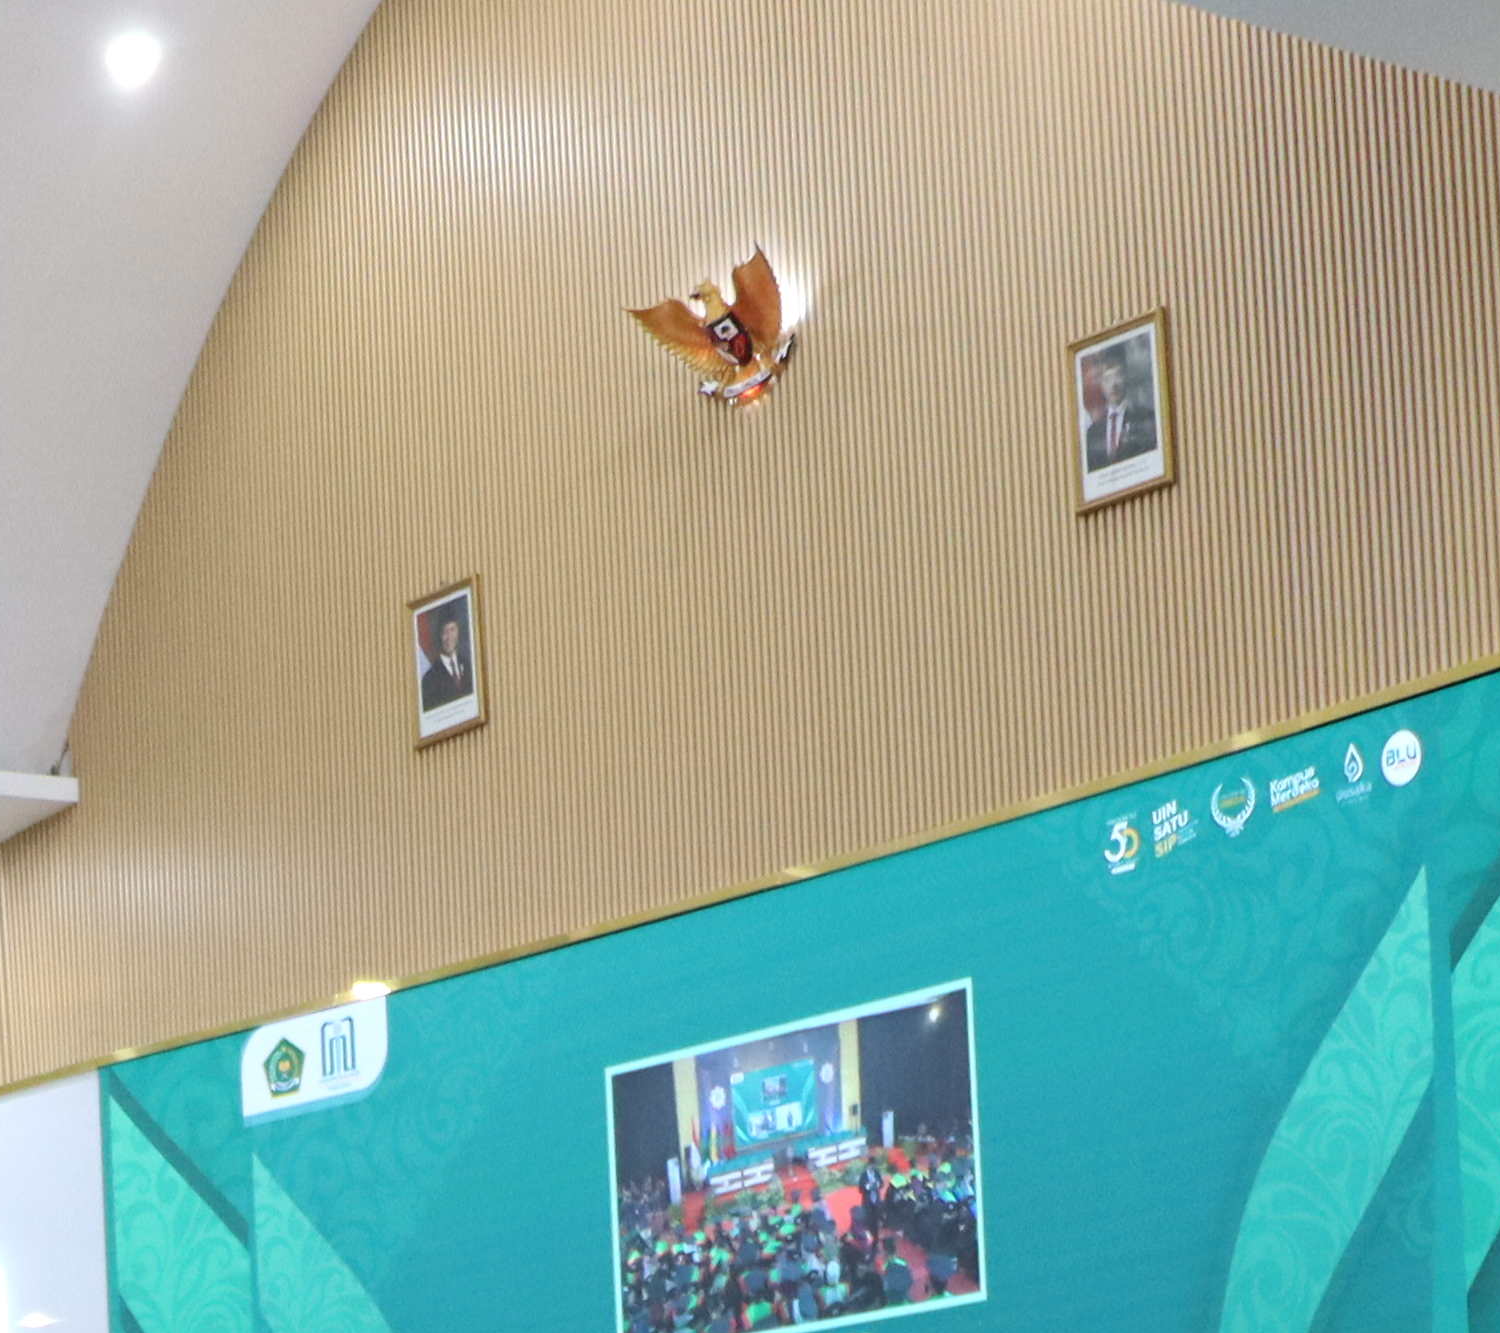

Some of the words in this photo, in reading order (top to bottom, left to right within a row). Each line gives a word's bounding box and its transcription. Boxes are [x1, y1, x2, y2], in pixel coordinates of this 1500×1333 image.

[1386, 743, 1417, 766] BLU
[1152, 800, 1177, 824] UIN
[1153, 810, 1189, 841] SATU
[1154, 833, 1178, 858] SIP
